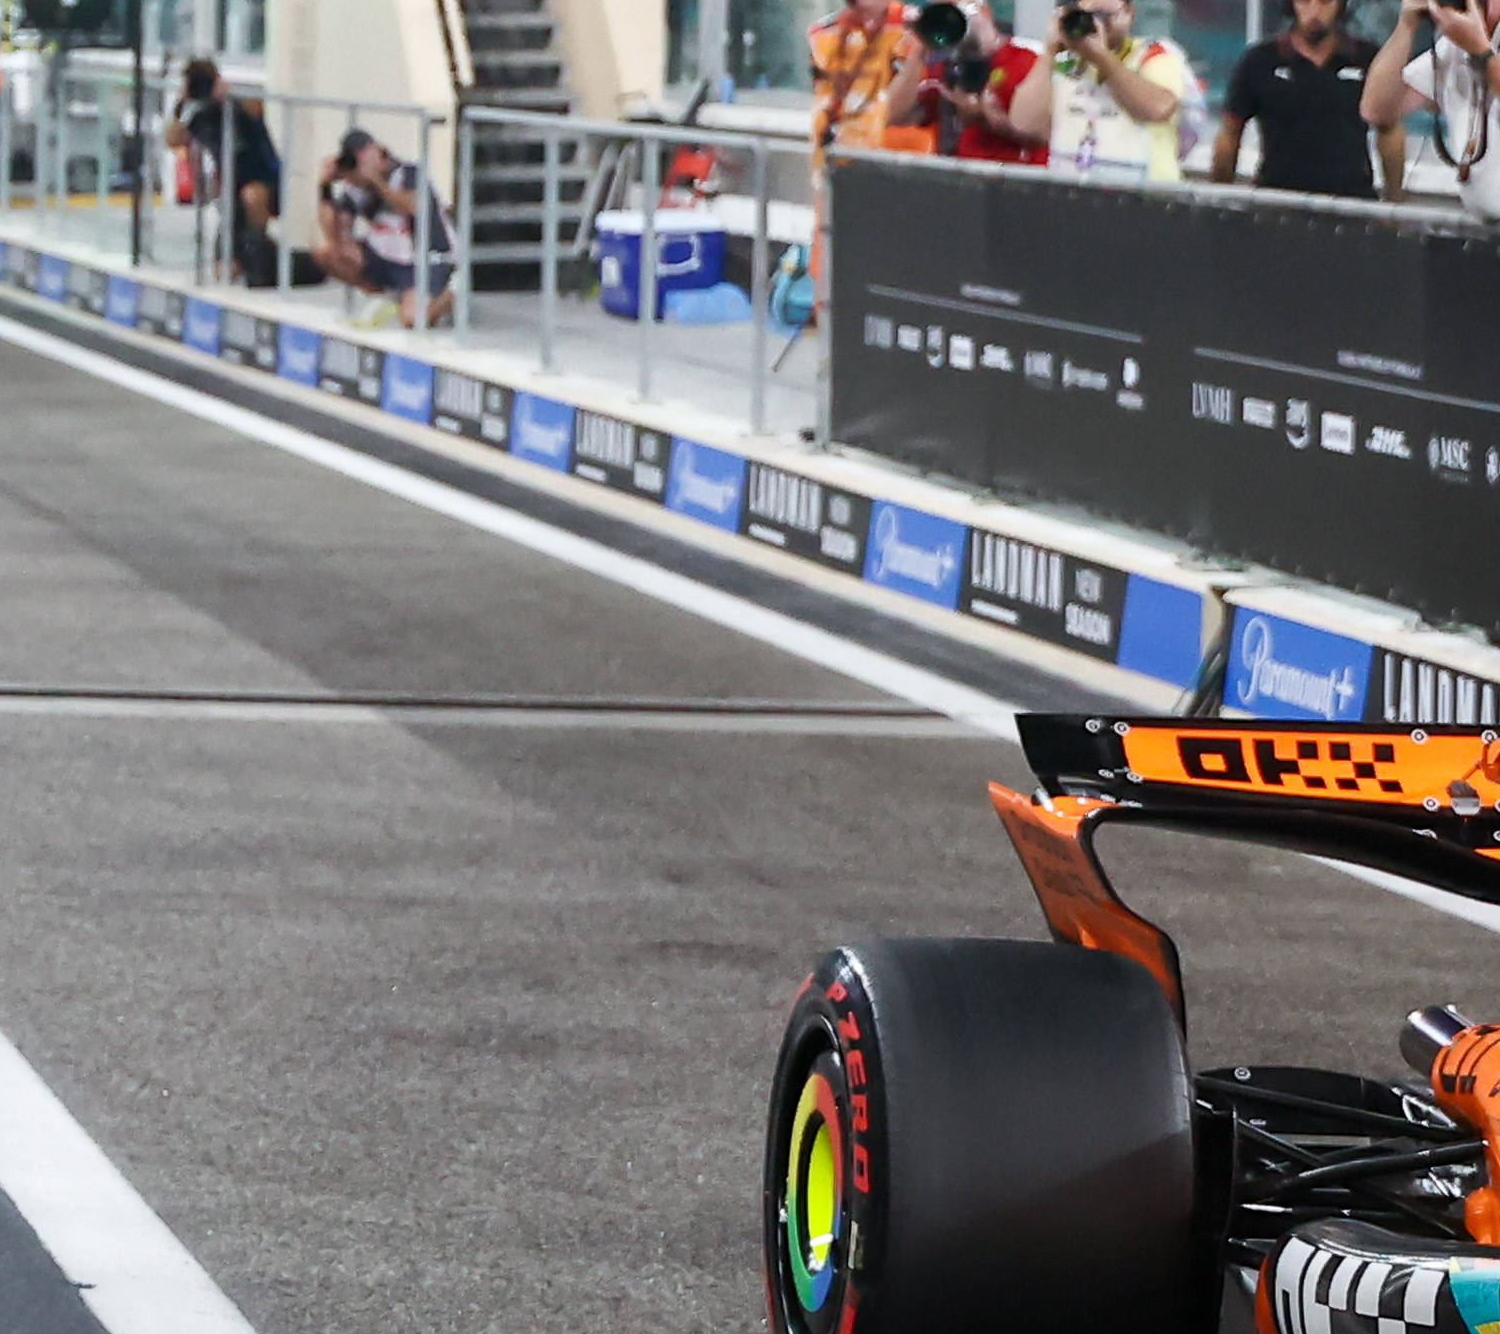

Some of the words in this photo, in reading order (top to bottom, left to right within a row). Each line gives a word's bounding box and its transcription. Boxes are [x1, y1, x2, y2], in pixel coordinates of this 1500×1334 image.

[970, 527, 1064, 613] LANDMAN
[1237, 616, 1355, 722] Paramount+
[1383, 650, 1498, 725] LANDMA
[1176, 735, 1404, 795] OKX
